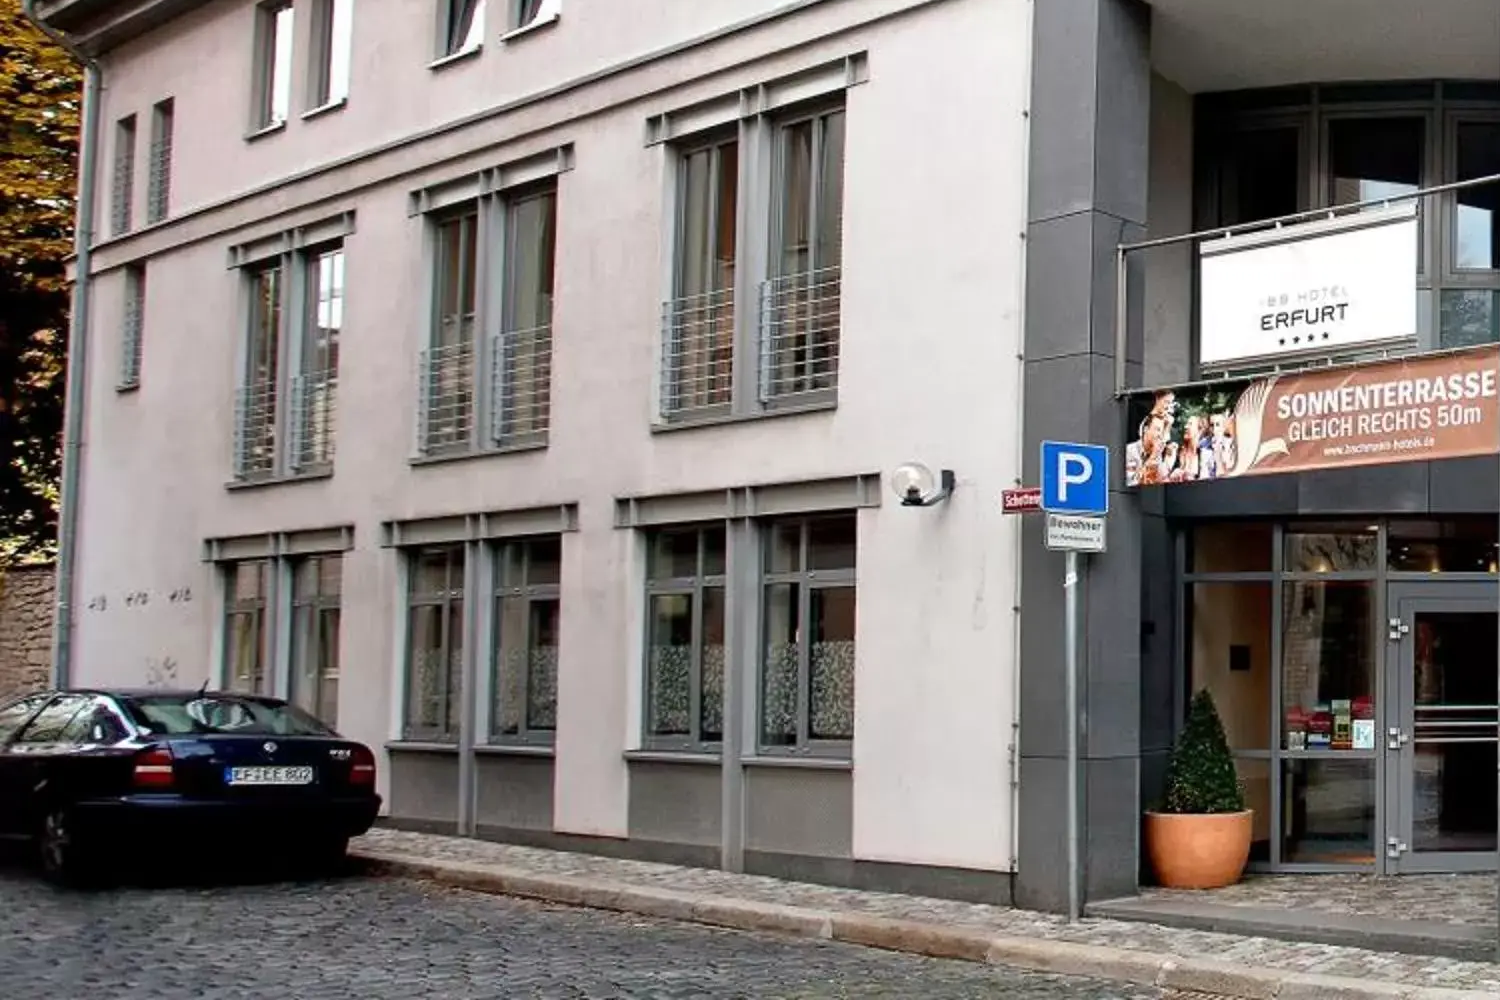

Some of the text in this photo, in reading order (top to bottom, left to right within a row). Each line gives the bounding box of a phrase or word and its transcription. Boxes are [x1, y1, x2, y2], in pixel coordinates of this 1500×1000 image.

[1260, 302, 1349, 331] ERFURT
[1277, 369, 1497, 420] SONNENTERRASSE
[1288, 404, 1482, 443] GLEICH RECHTS 50m
[1058, 452, 1093, 503] P
